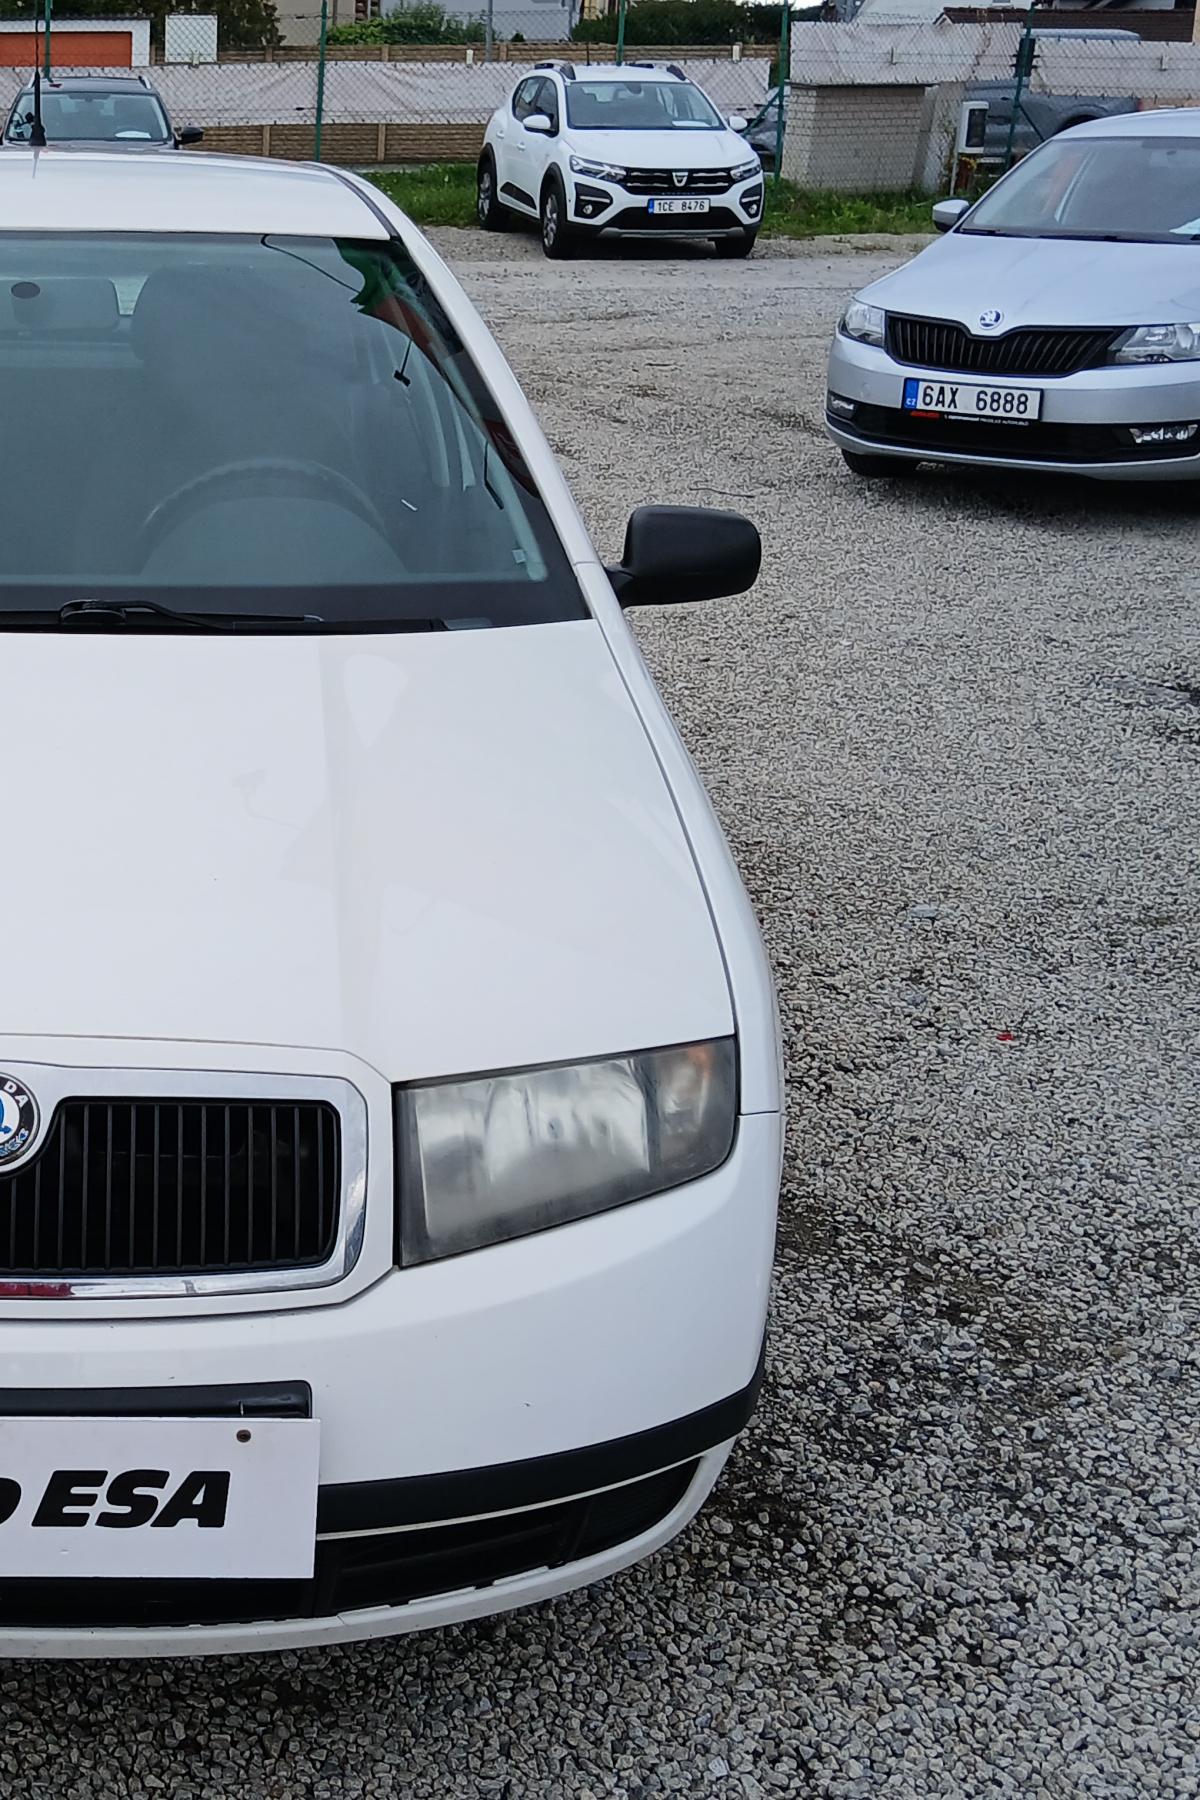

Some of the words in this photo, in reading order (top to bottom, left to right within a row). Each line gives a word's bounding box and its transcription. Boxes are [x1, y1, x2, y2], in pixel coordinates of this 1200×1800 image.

[658, 201, 674, 212] 1CE
[681, 200, 705, 211] 8476
[922, 385, 959, 409] 6AX
[975, 390, 1029, 415] 6888
[31, 1469, 230, 1529] ESA
